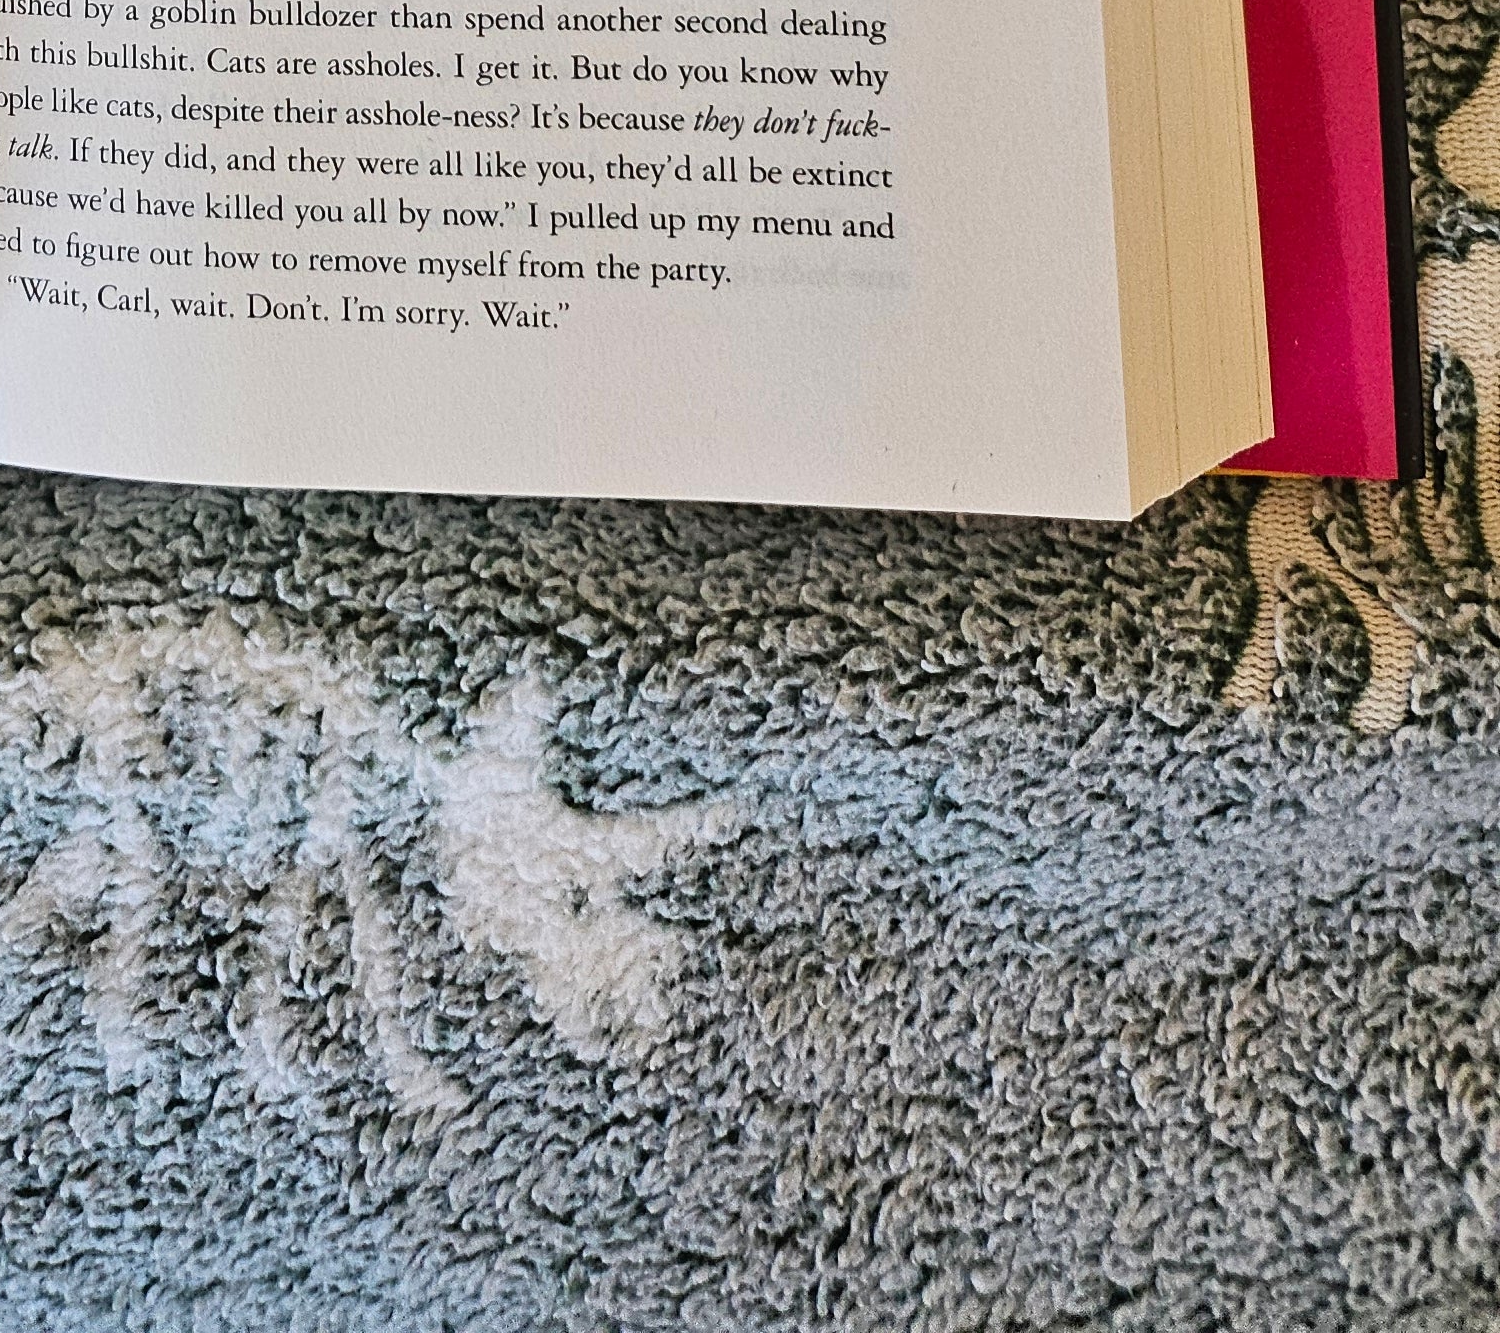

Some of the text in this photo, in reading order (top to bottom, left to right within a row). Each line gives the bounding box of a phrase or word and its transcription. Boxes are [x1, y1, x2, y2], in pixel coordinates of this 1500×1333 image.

[33, 236, 55, 256] to
[66, 232, 139, 267] figure
[150, 248, 193, 266] out
[204, 242, 260, 270] how
[271, 252, 297, 270] to
[309, 254, 406, 273] remove
[418, 250, 511, 283] myself
[518, 250, 585, 279] from
[596, 253, 640, 280] the
[650, 263, 731, 290] party.
[98, 285, 159, 319] Carl,
[170, 292, 234, 318] wait.
[396, 306, 469, 333] sorry.
